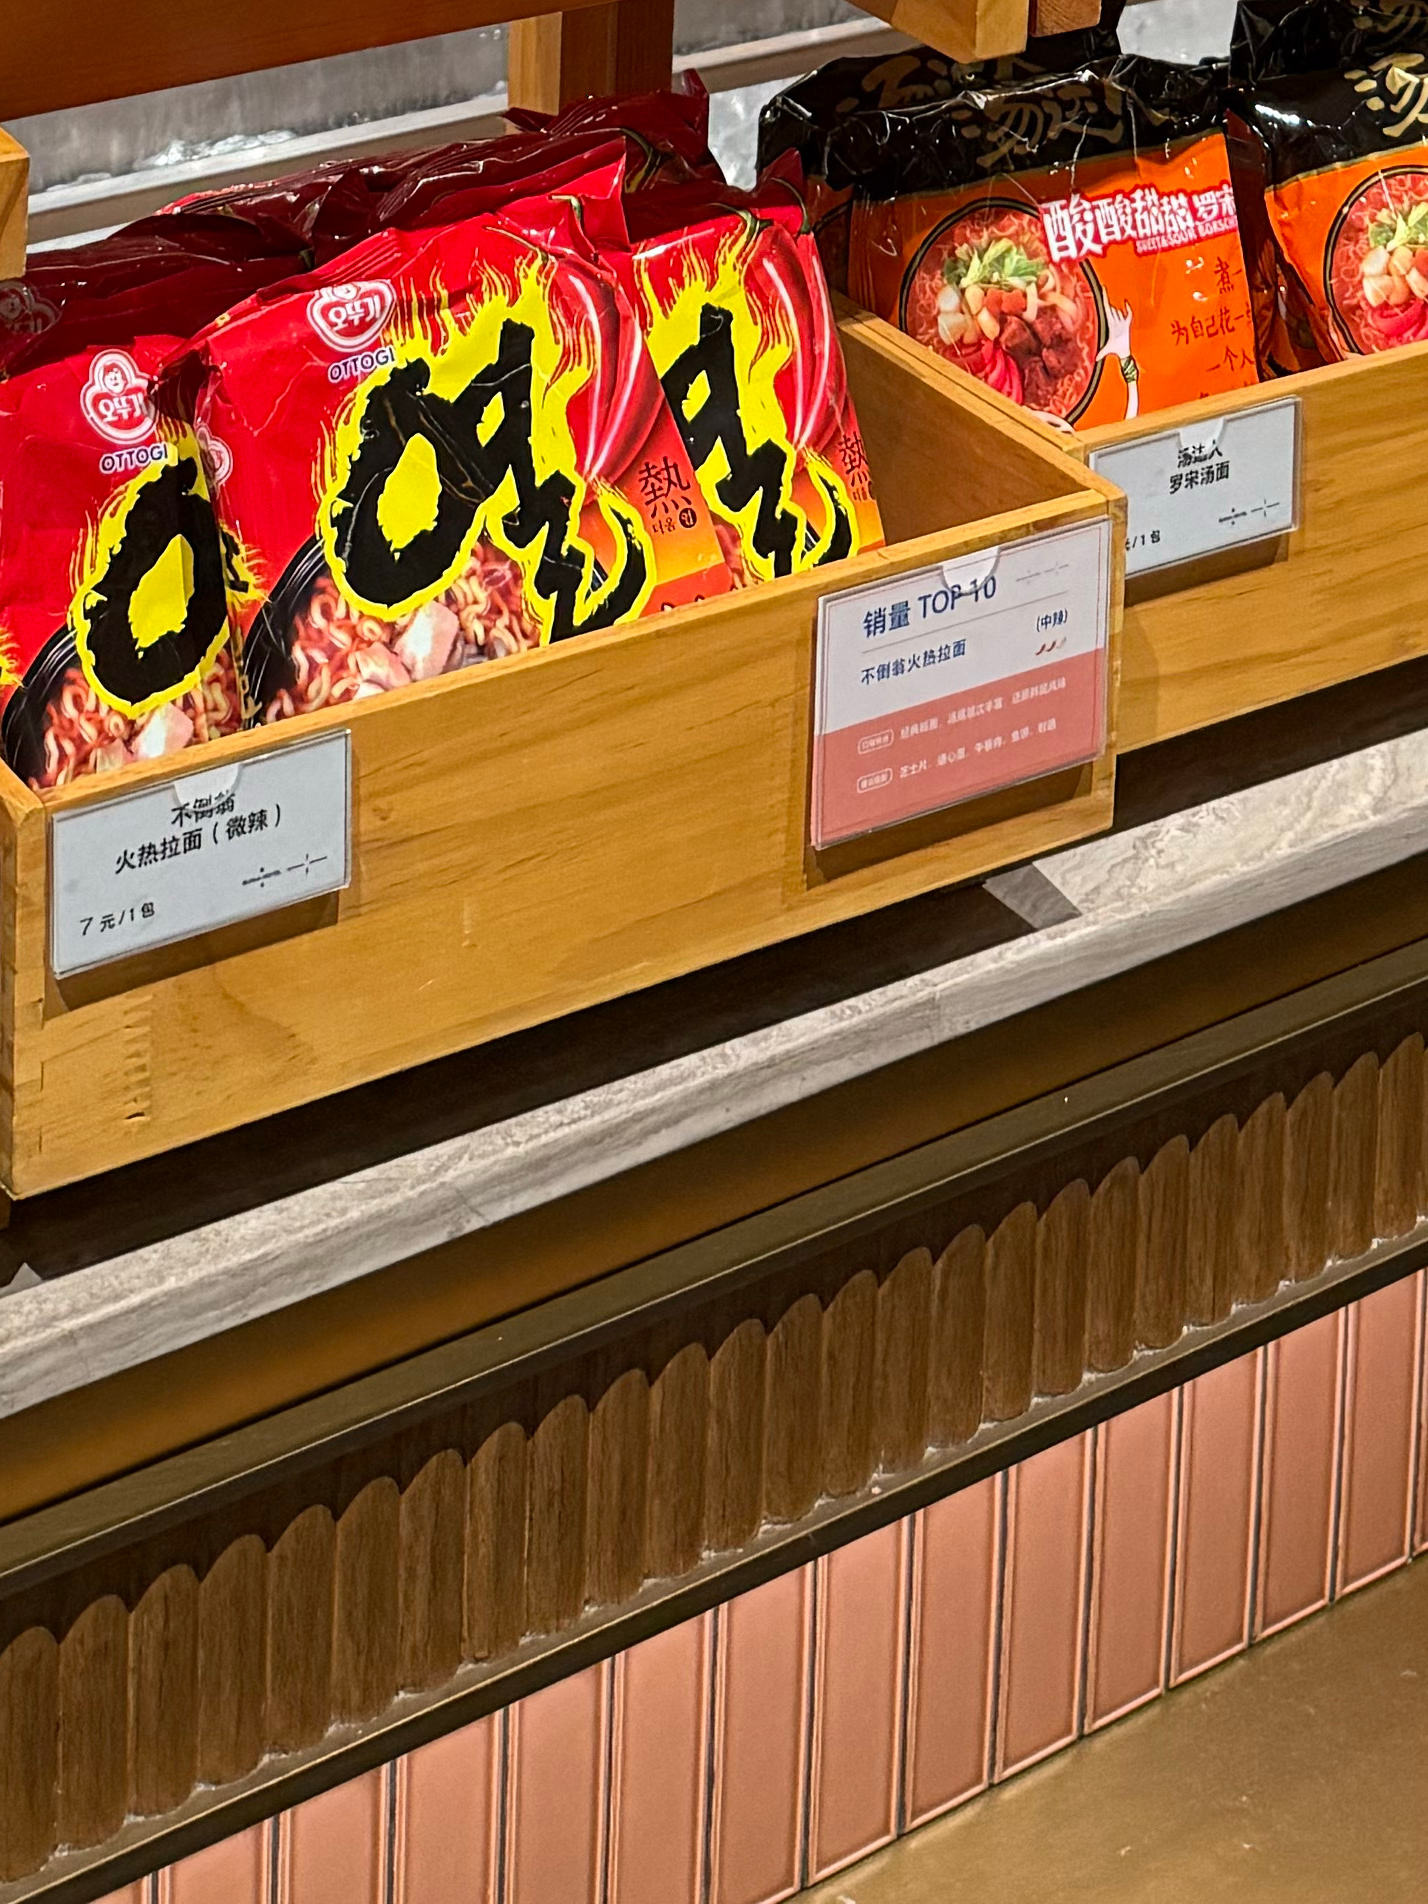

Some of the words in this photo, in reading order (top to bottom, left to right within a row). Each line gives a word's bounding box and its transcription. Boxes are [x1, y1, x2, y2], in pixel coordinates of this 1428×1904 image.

[327, 298, 382, 328] 오뚜기
[327, 347, 396, 384] OTTOGI
[99, 442, 171, 474] OTTOGI
[638, 455, 693, 520] 熱
[1169, 460, 1230, 495] 罗宋汤面
[862, 599, 911, 639] 销量
[918, 584, 962, 619] TOP
[970, 575, 998, 603] 10
[861, 638, 967, 686] 不倒翁火热拉面
[172, 792, 236, 828] 不倒翁
[80, 918, 94, 937] 7
